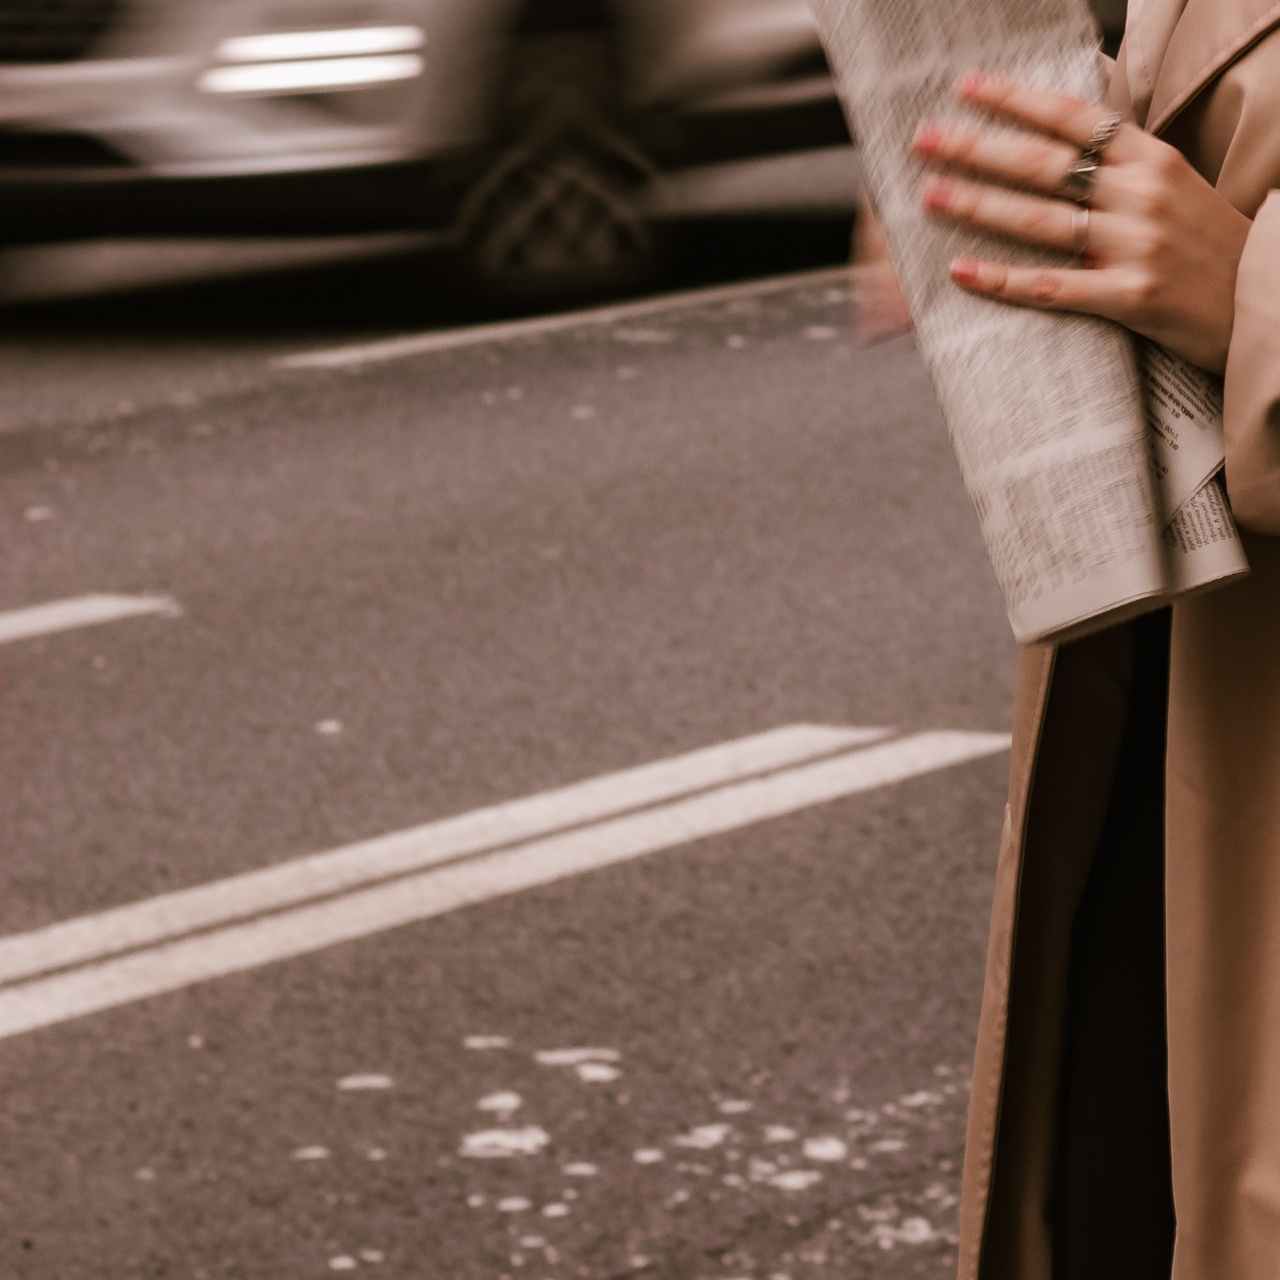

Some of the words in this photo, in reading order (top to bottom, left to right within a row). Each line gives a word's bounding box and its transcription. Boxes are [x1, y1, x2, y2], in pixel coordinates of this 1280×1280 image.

[1172, 409, 1180, 418] 1:0
[1180, 405, 1194, 420] тура
[1169, 441, 1179, 450] 1:0
[1188, 512, 1203, 548] сдержанно
[1196, 510, 1210, 545] Исполкома
[1201, 502, 1218, 542] официально
